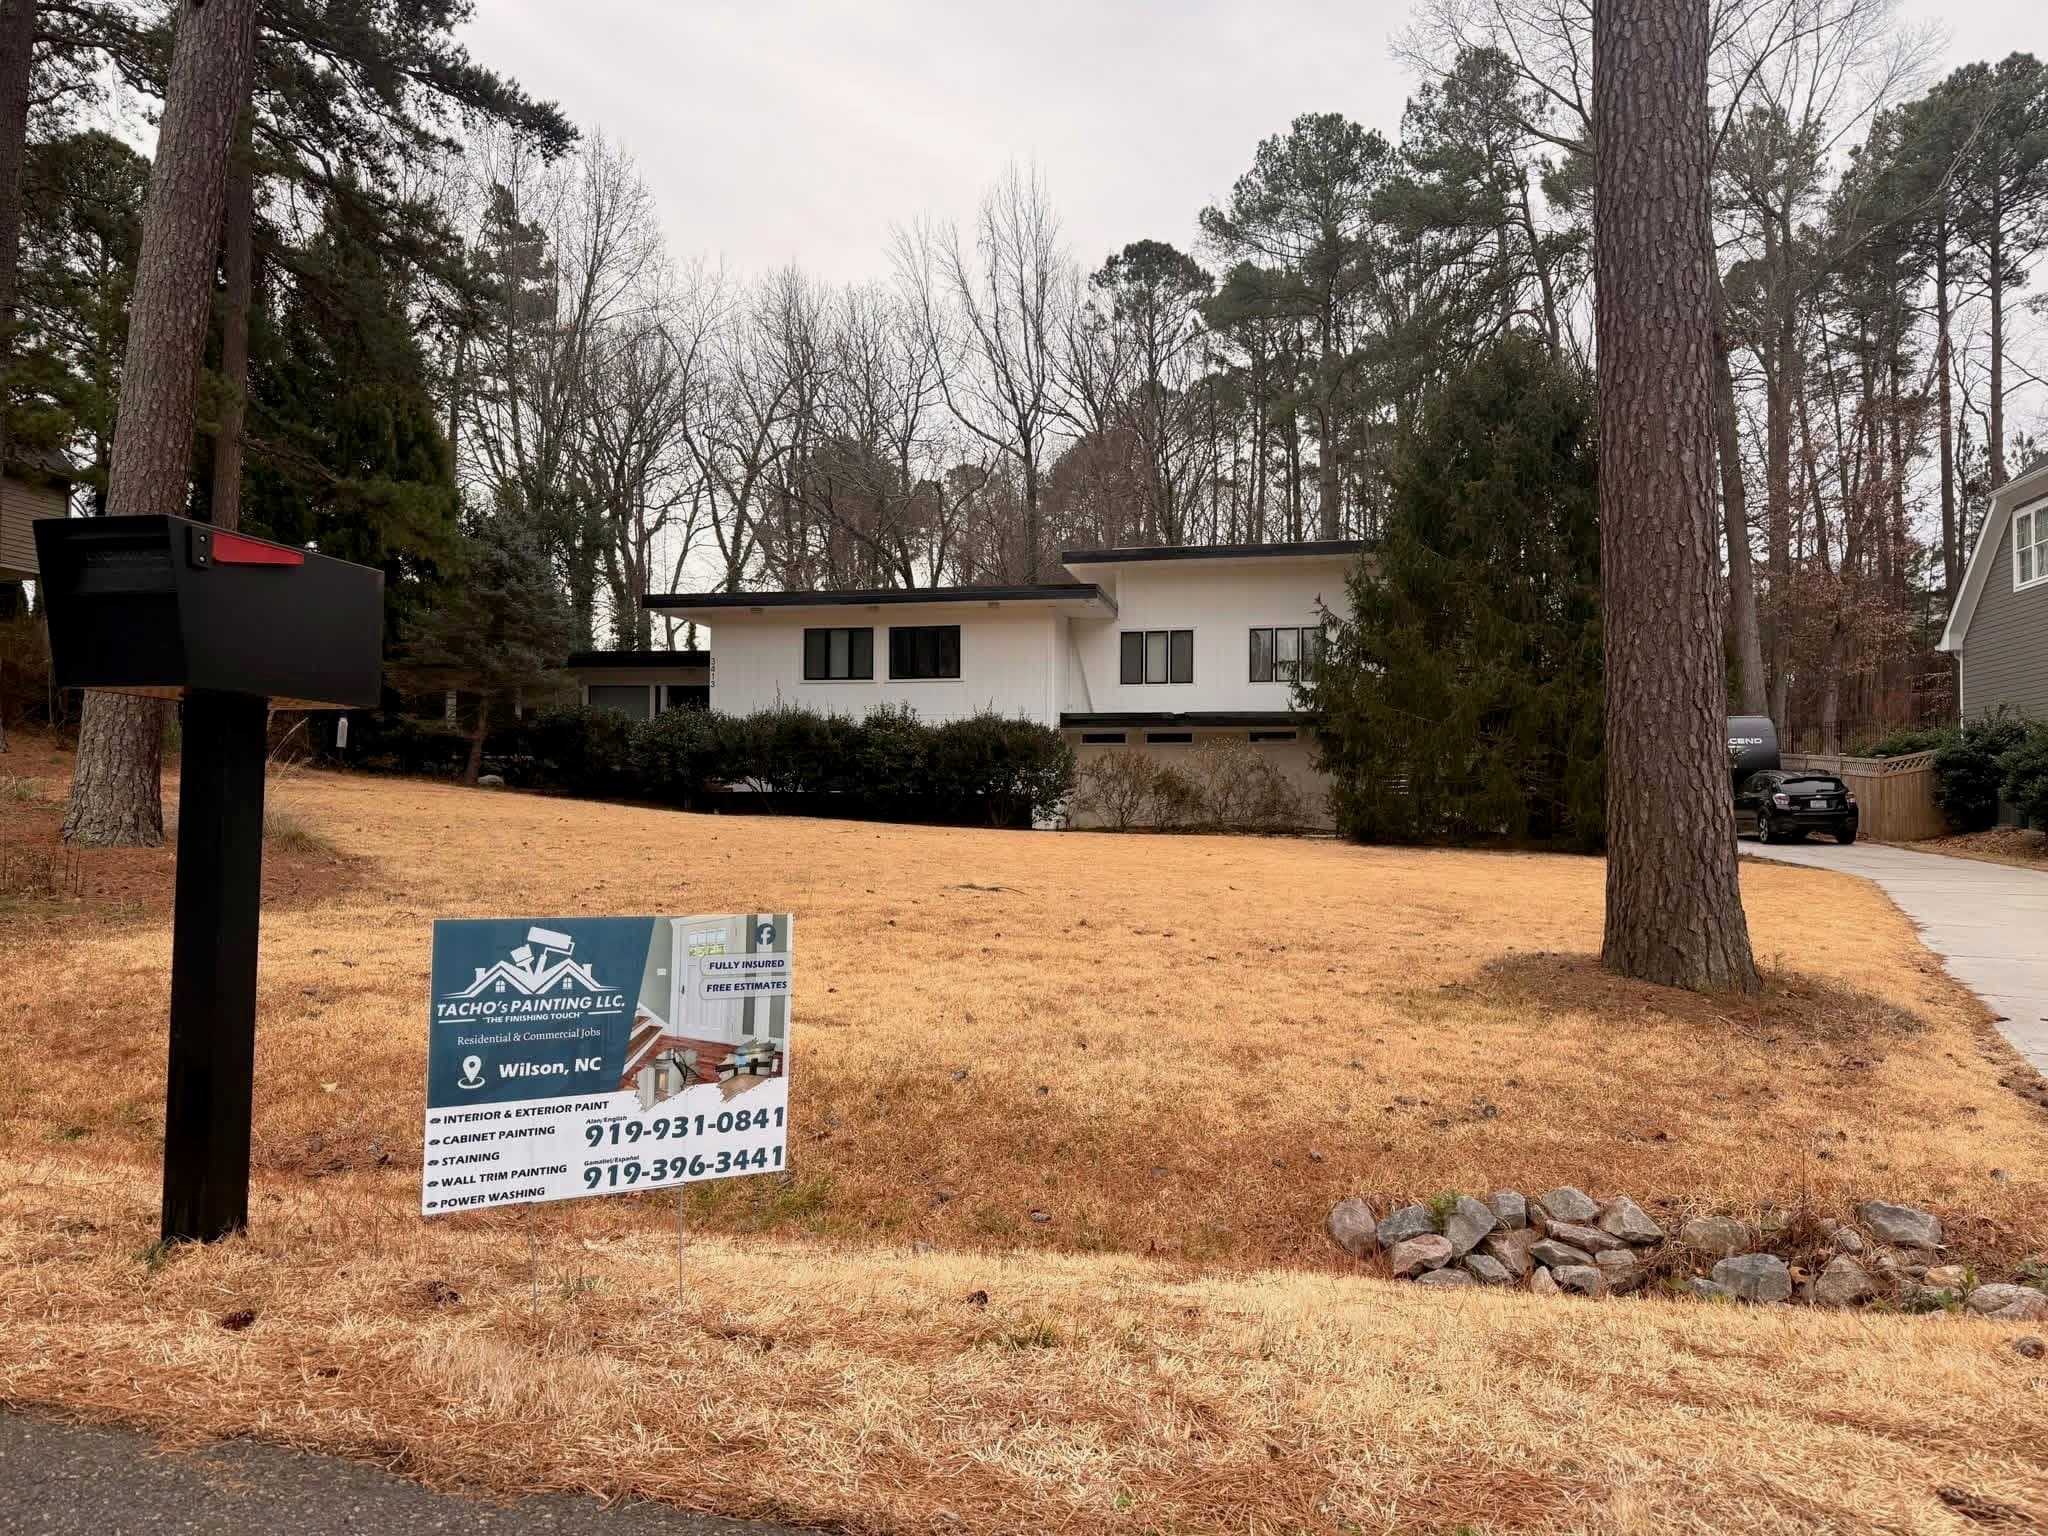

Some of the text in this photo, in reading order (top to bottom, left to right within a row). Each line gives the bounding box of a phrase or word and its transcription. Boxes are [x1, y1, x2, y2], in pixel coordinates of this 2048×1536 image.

[709, 959, 785, 970] FULLY INSURED
[706, 981, 787, 992] FREE ESTIMATES
[436, 994, 625, 1017] TACHO's PAINTING LLC.
[504, 1014, 549, 1023] FINISHING
[457, 1027, 601, 1046] Residential & Commercial Jobs
[498, 1057, 602, 1078] Wilson, NC
[443, 1101, 610, 1125] INTERIOR & EXTERIOR PAINT
[442, 1126, 556, 1145] CABINET PAINTING
[585, 1106, 784, 1148] 919-931-0841
[441, 1151, 500, 1167] STAINING
[583, 1145, 783, 1189] 919-396-3441
[440, 1164, 568, 1188] WALL TRIM PAINTING
[440, 1187, 546, 1209] POWER WASHING
